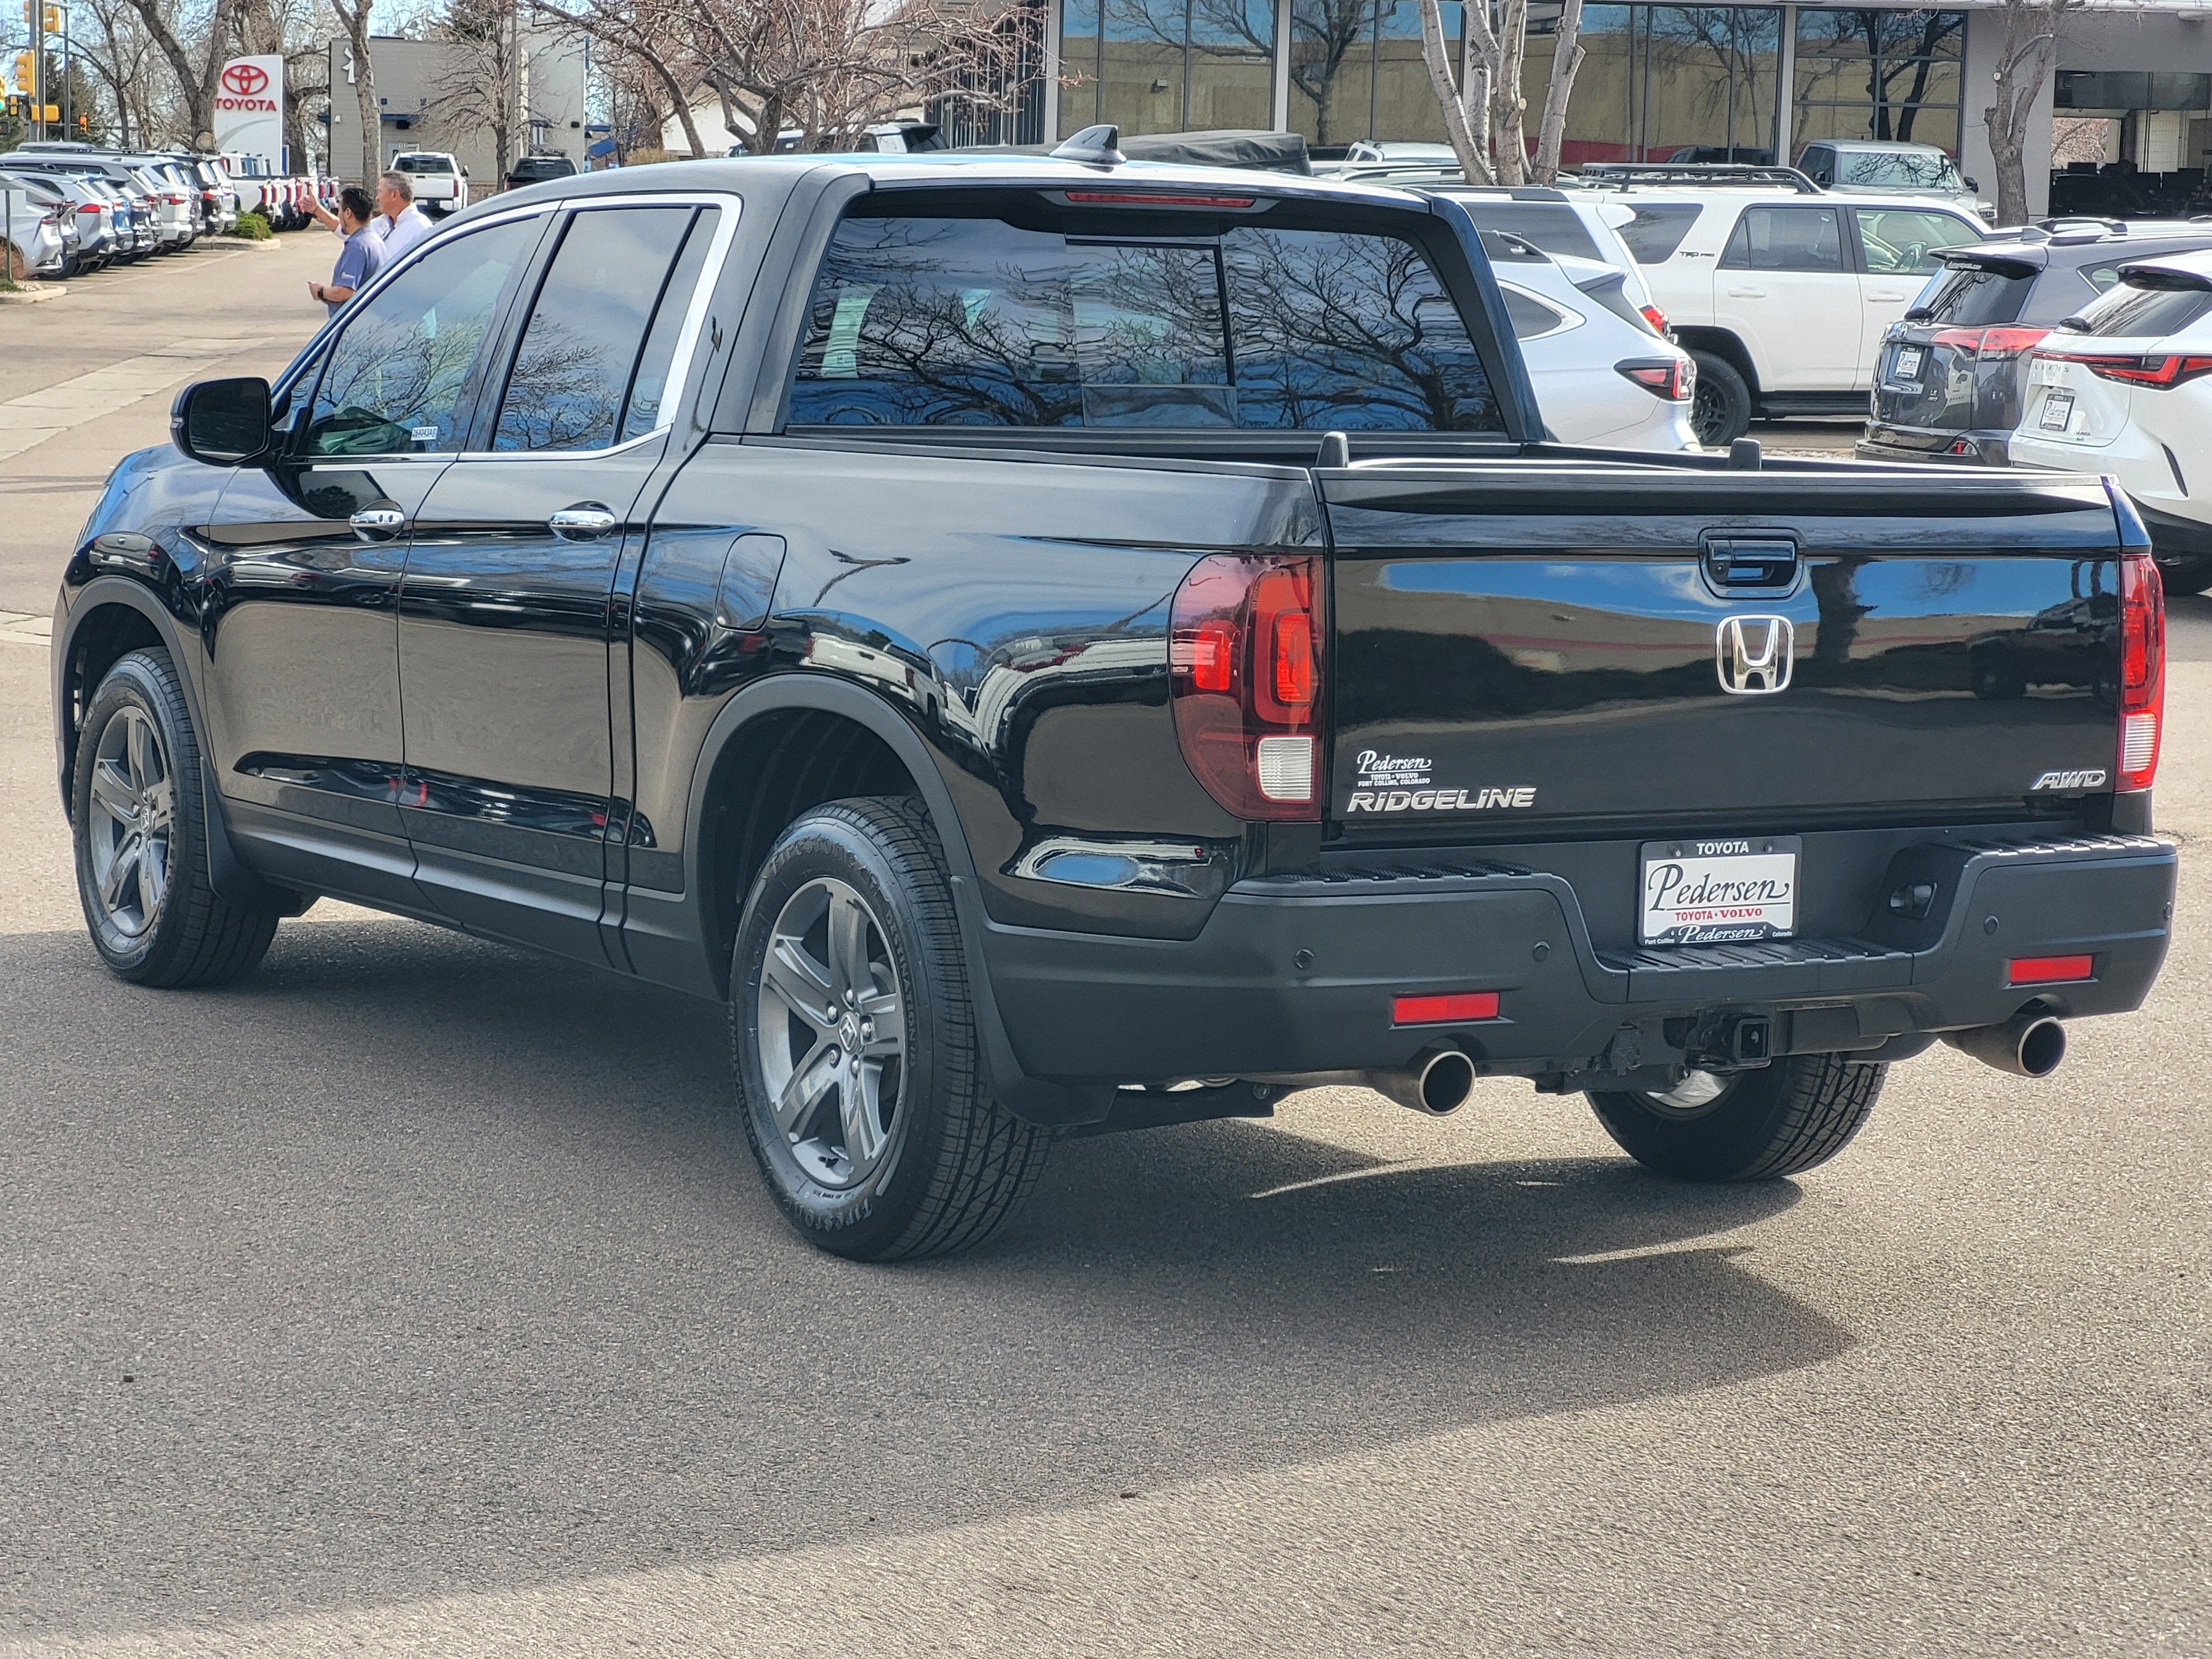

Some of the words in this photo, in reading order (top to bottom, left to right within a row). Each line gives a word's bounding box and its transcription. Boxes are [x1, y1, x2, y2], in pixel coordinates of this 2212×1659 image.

[216, 98, 276, 111] TOYOTA
[1357, 750, 1432, 774] Pedersen
[2030, 770, 2106, 790] AWD
[1347, 787, 1537, 813] RIDGELINE
[1696, 841, 1749, 855] TOYOTA
[1648, 863, 1790, 911] Pedersen
[1675, 910, 1713, 922] TOYOTA
[1719, 908, 1763, 919] VOLVO
[1678, 924, 1764, 944] Pedersen
